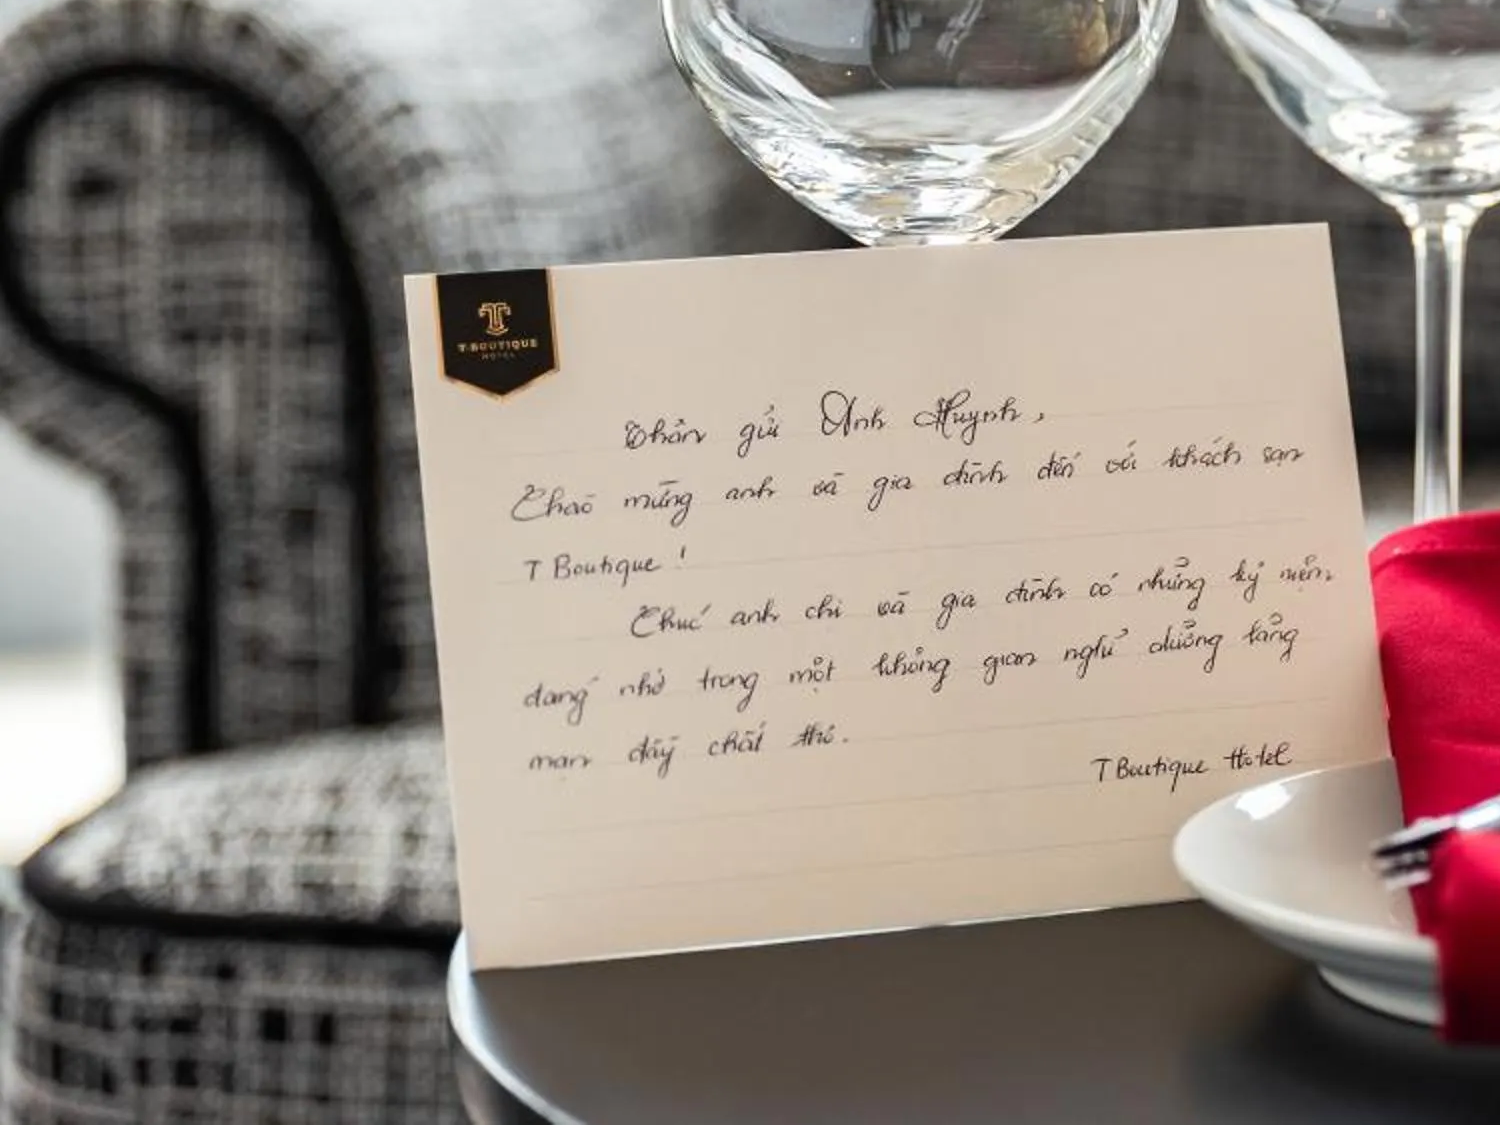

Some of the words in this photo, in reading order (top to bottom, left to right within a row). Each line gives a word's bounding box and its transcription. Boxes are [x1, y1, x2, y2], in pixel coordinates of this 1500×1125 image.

[724, 475, 777, 501] anh
[866, 474, 915, 513] gia
[523, 559, 543, 582] T
[553, 553, 662, 588] Boutique
[729, 598, 781, 627] anh
[937, 590, 977, 631] gia
[698, 667, 760, 714] trong
[982, 651, 1038, 686] gian
